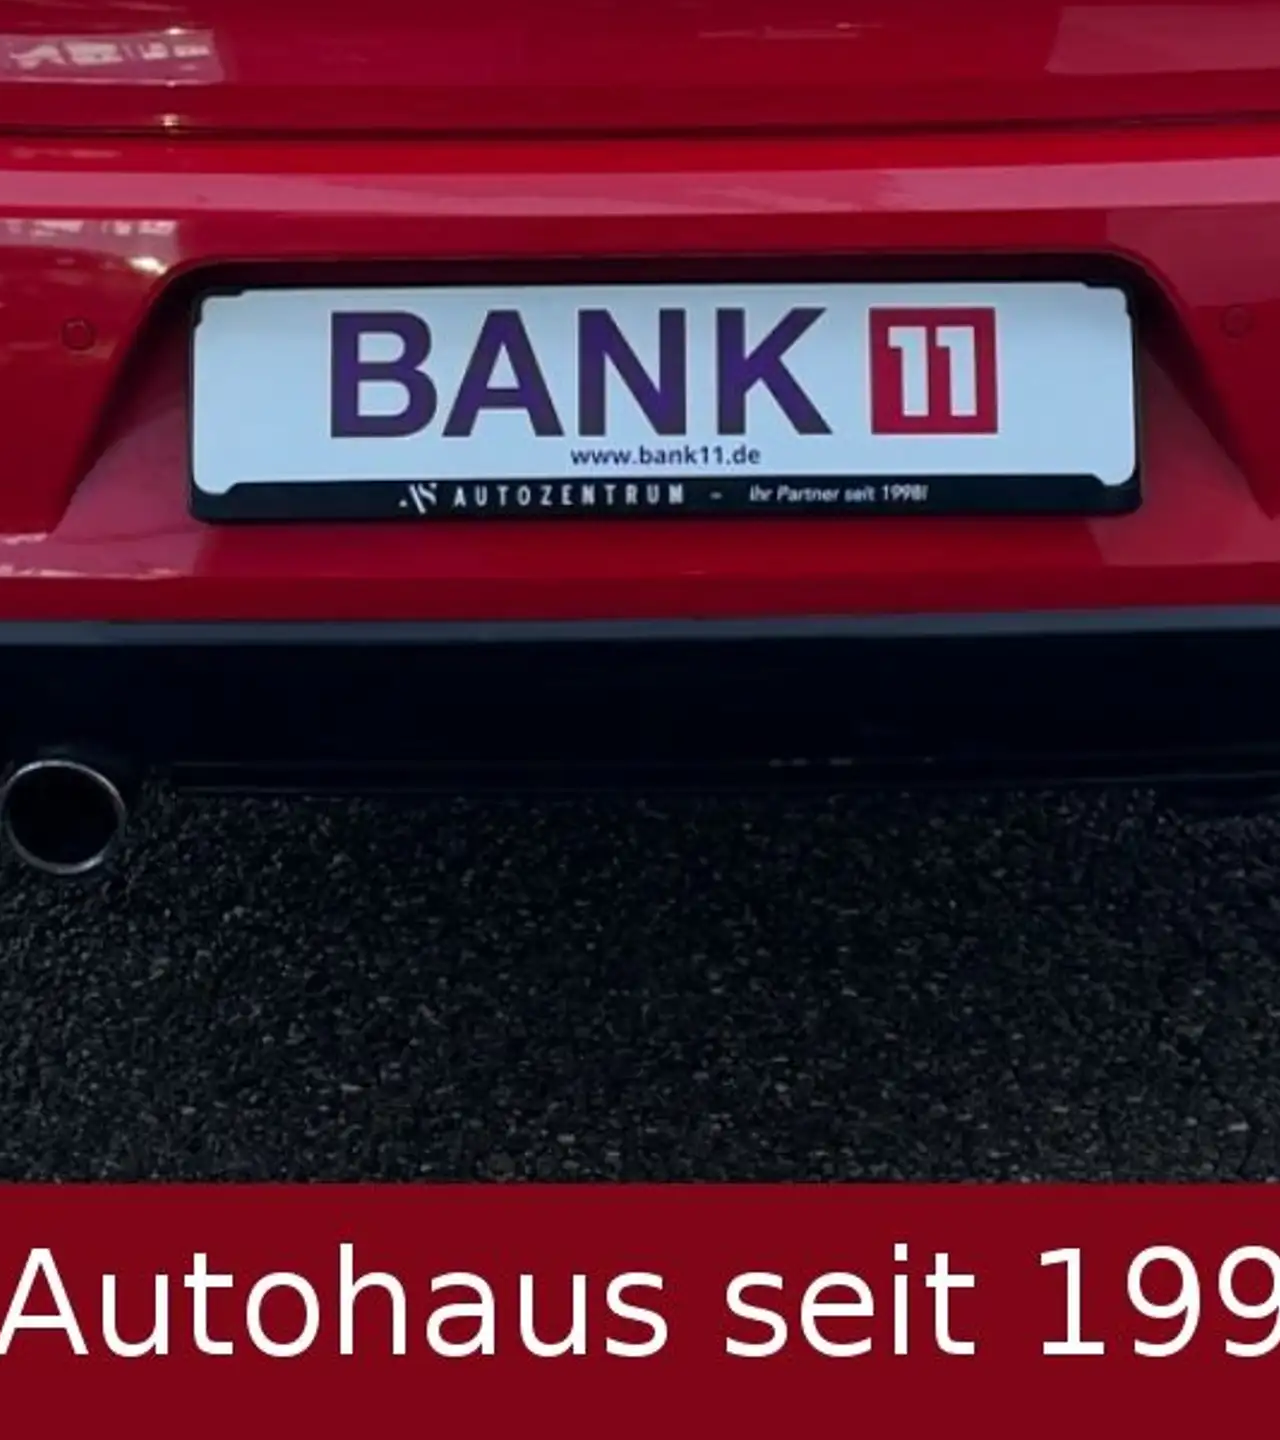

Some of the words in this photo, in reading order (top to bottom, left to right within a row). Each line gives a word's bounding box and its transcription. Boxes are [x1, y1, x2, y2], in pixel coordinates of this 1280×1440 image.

[330, 306, 833, 438] BANK
[888, 325, 978, 417] 11
[570, 444, 762, 466] www.bank11.de
[452, 483, 685, 507] AUTOZENTRUM
[749, 484, 773, 502] Ihr
[776, 484, 840, 502] Partner
[843, 484, 875, 502] seit
